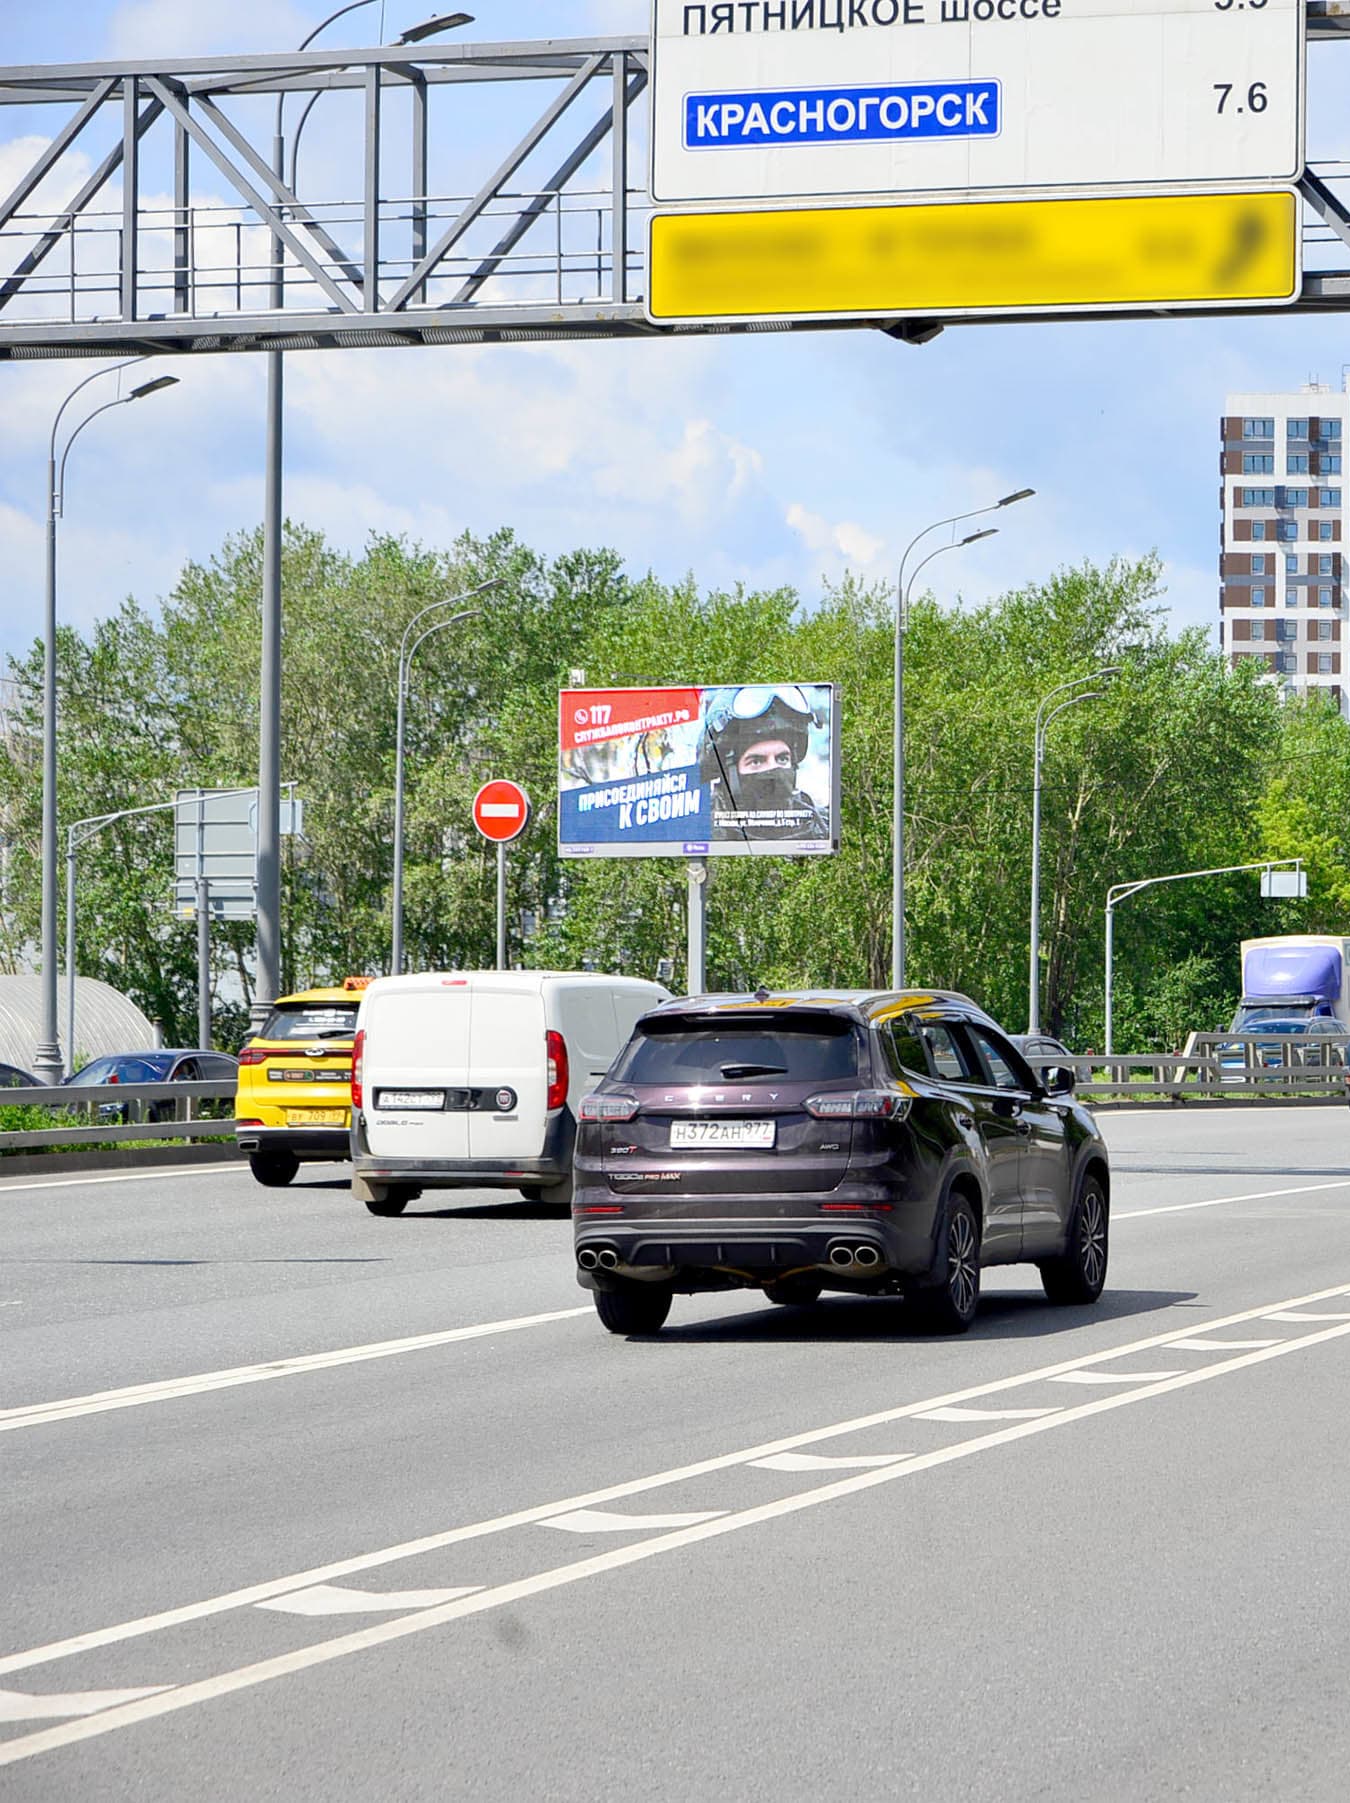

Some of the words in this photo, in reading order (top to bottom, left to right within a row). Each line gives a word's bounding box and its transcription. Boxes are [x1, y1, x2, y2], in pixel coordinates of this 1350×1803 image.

[683, 0, 925, 35] ПЯТНИЦКОЕ
[941, 0, 1061, 22] шоссе
[696, 92, 990, 138] КРАСНОГОРСК
[1213, 82, 1268, 114] 7.6
[589, 704, 612, 725] 117
[578, 773, 687, 812] ПРИСОЕДИНЯЙСЯ
[619, 803, 633, 830] К
[636, 789, 701, 826] СВОИМ
[664, 1092, 779, 1102] CERY
